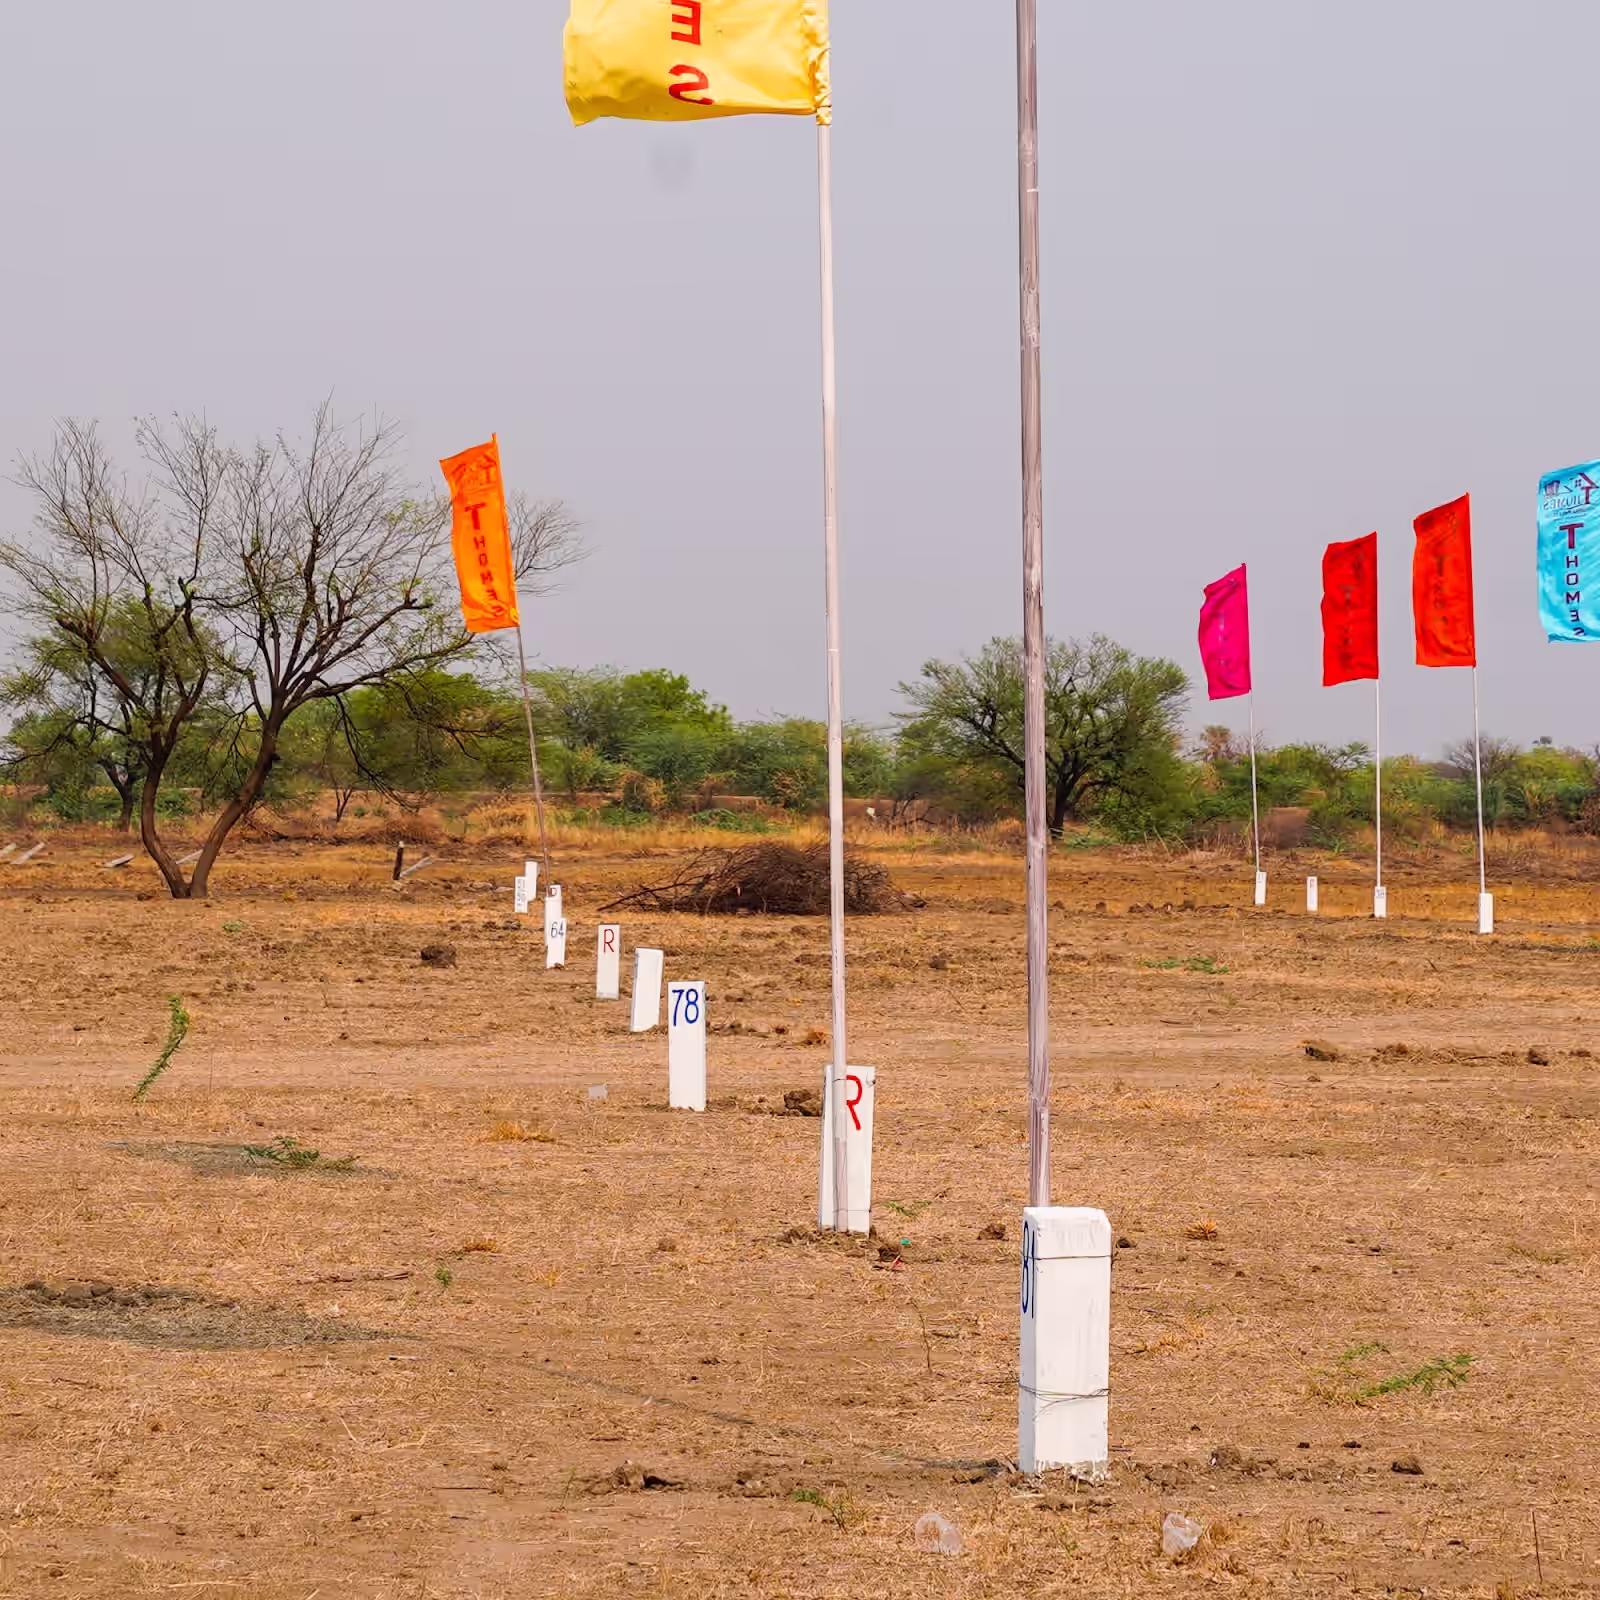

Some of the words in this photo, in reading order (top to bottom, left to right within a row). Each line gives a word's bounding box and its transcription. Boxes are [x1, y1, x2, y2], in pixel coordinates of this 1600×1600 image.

[550, 921, 564, 939] 64
[603, 928, 615, 953] R
[672, 988, 700, 1028] 78
[846, 1074, 863, 1132] R
